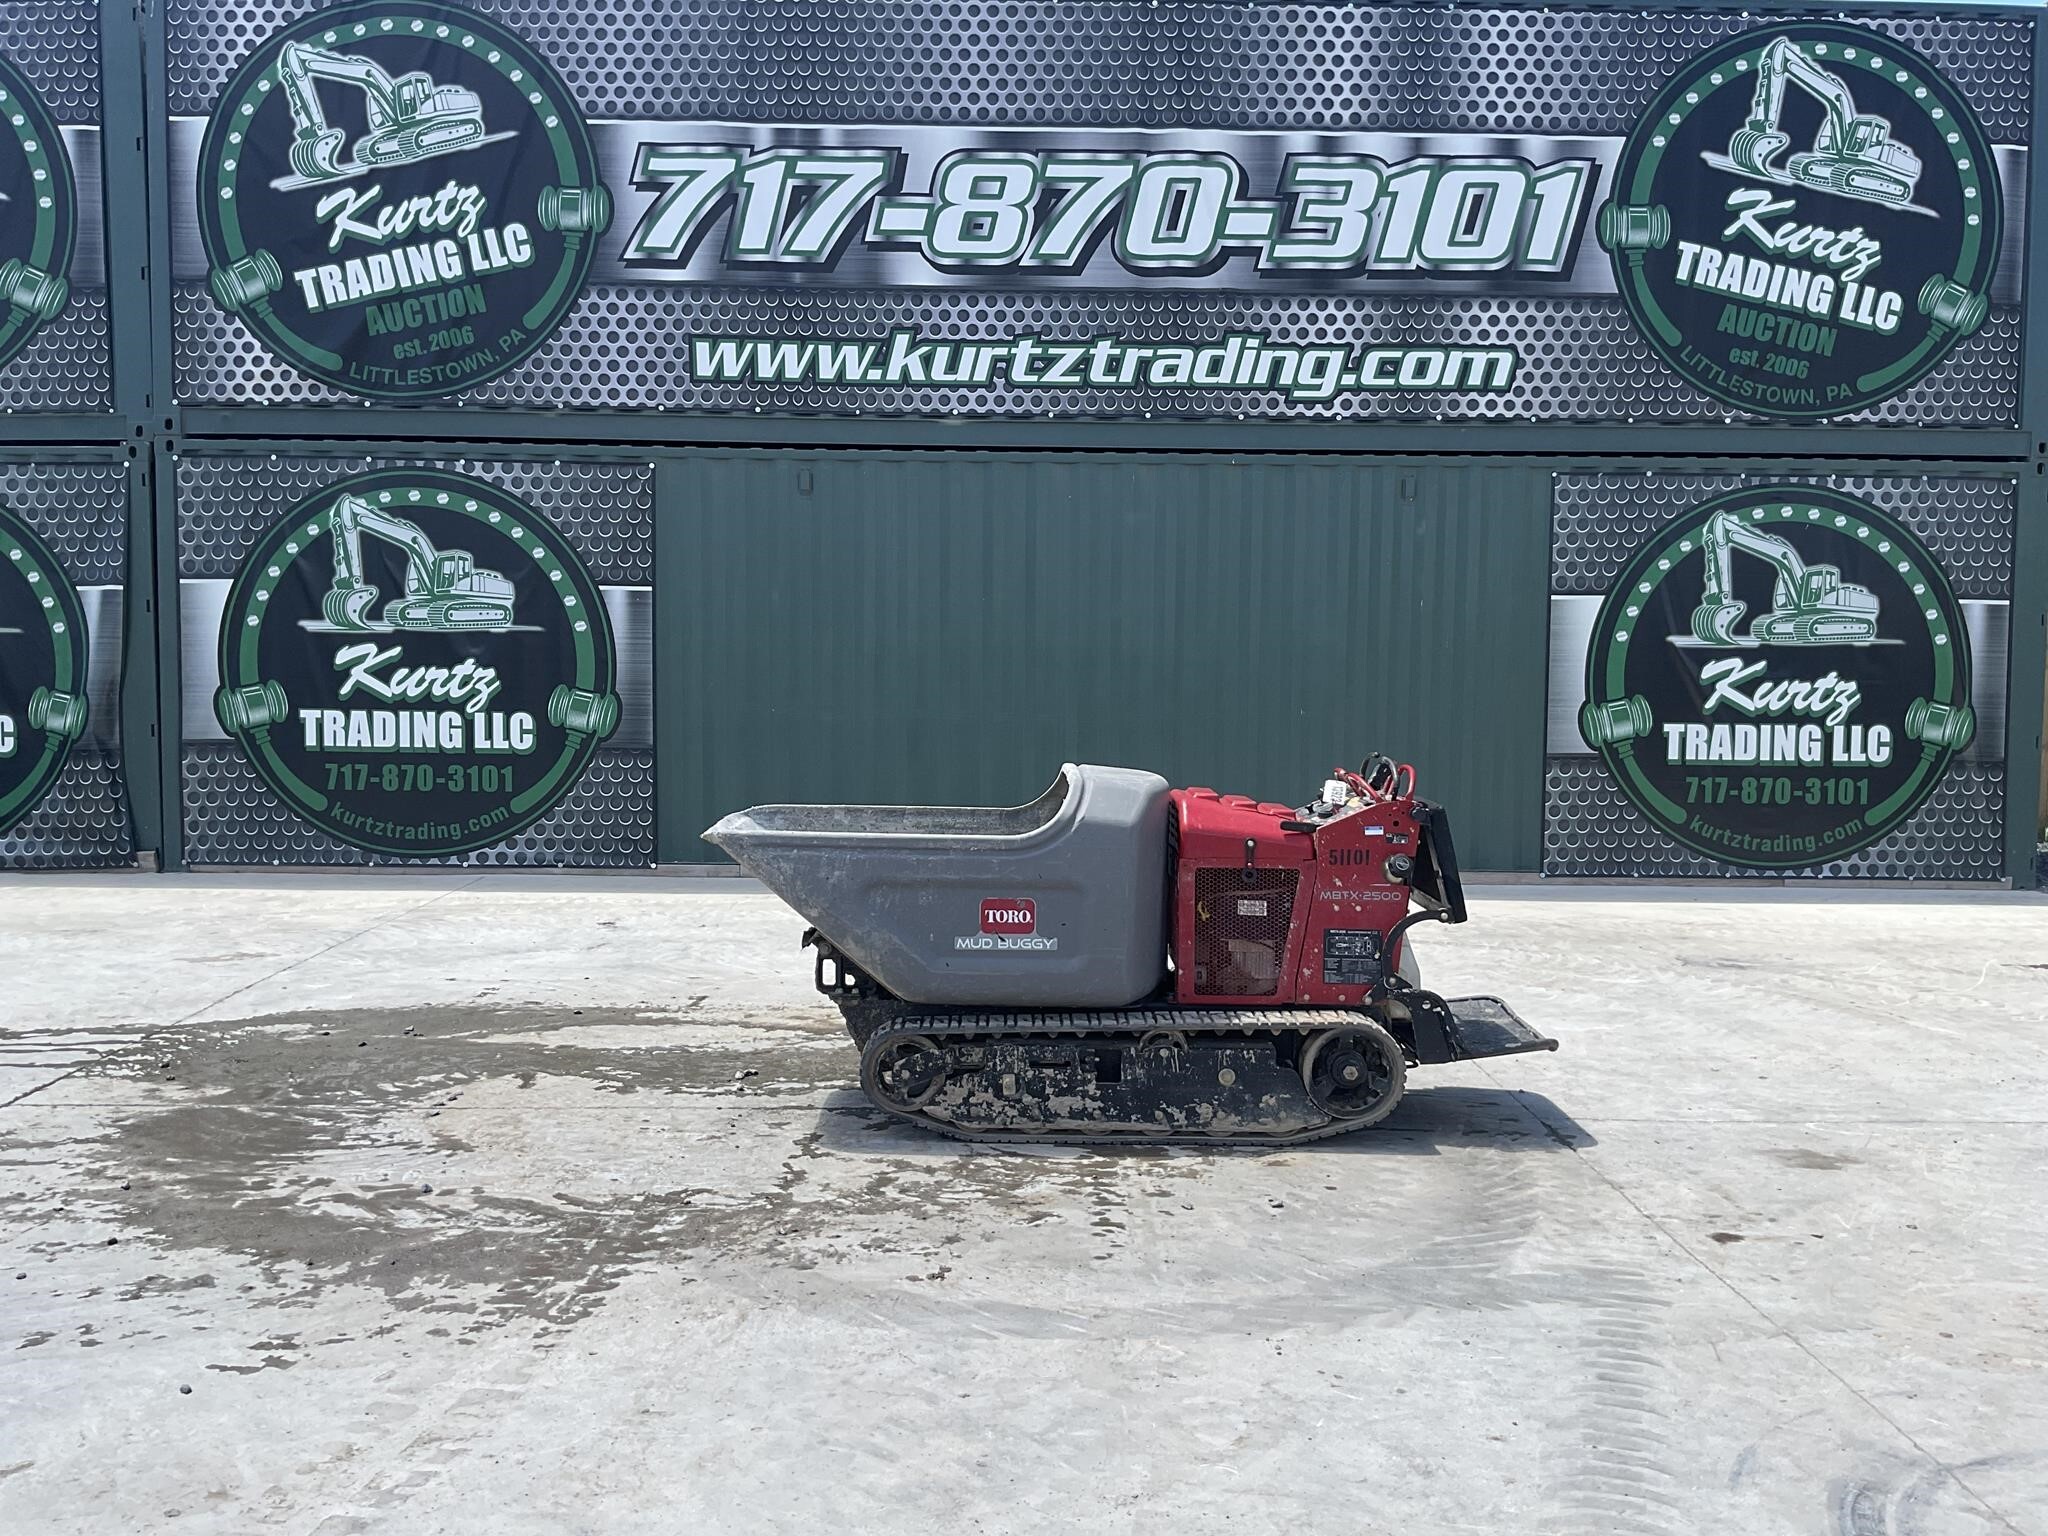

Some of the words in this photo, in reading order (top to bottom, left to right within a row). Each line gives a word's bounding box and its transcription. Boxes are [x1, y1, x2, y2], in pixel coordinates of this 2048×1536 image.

[316, 180, 487, 249] Kurtz
[626, 141, 1594, 274] 717-870-3101
[1722, 187, 1882, 282] Kurtz
[294, 239, 464, 311] TRADING
[466, 223, 533, 273] LLC
[1676, 241, 1836, 317] TRADING
[1838, 281, 1903, 332] LLC
[365, 284, 488, 336] AUCTION
[1716, 303, 1838, 357] AUCTION
[349, 348, 500, 386] LITTLESTOWN,
[498, 328, 527, 352] PA
[393, 338, 428, 360] est.
[428, 325, 476, 352] 2006
[688, 330, 1519, 402] www.kurtztrading.com
[1728, 347, 1760, 369] est.
[1762, 352, 1811, 380] 2006
[1679, 344, 1822, 407] LITTLESTOWN,
[1826, 383, 1853, 402] PA
[335, 643, 500, 713] Kurtz
[1699, 657, 1861, 726] Kurtz
[299, 708, 463, 750] TRADING
[474, 711, 536, 752] LLC
[1662, 723, 1823, 763] TRADING
[1832, 724, 1892, 764] LLC
[325, 763, 514, 793] 717-870-3101
[1685, 776, 1869, 805] 717-870-3101
[329, 800, 511, 841] kurtztrading.com
[1688, 813, 1863, 854] kurtztrading.com
[1329, 849, 1371, 866] 51101
[984, 909, 1032, 924] TORO
[956, 937, 993, 949] MUD
[997, 937, 1054, 949] BUGGY
